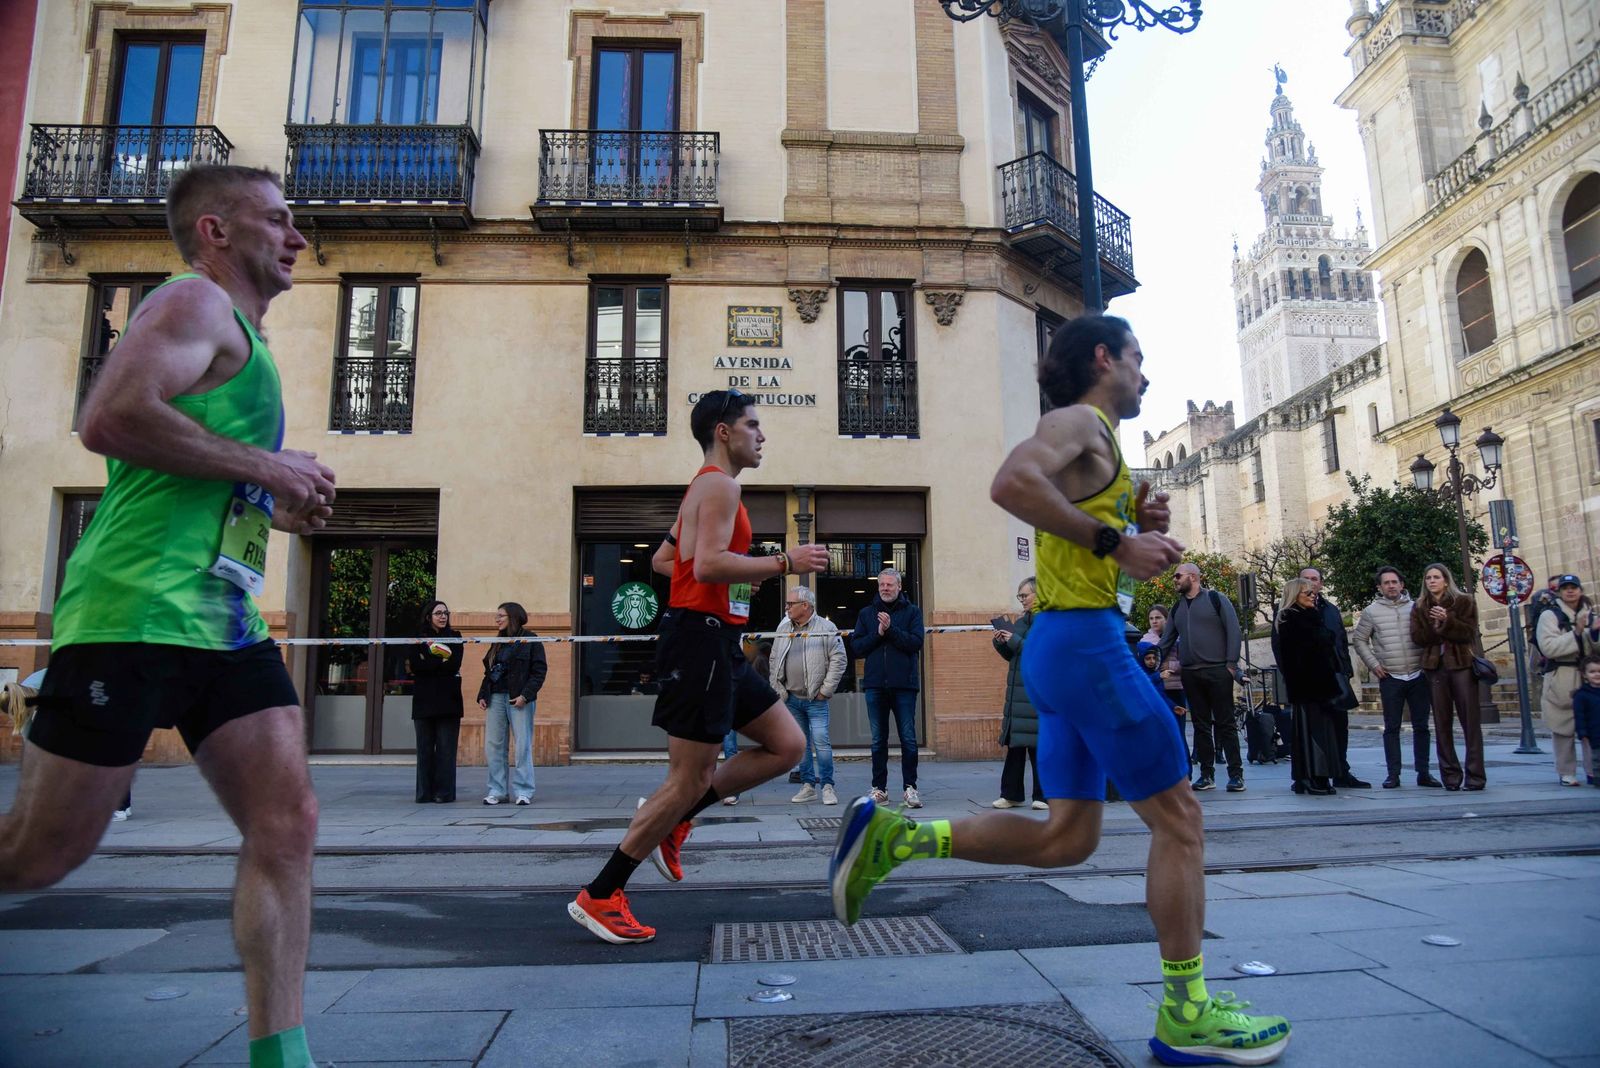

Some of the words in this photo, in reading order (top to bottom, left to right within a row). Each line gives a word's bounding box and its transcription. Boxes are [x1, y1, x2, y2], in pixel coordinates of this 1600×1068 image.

[740, 328, 769, 337] GENOVA
[715, 357, 791, 369] AVENIDA
[728, 375, 750, 387] DE
[757, 376, 780, 387] LA
[687, 392, 816, 405] CTUCION
